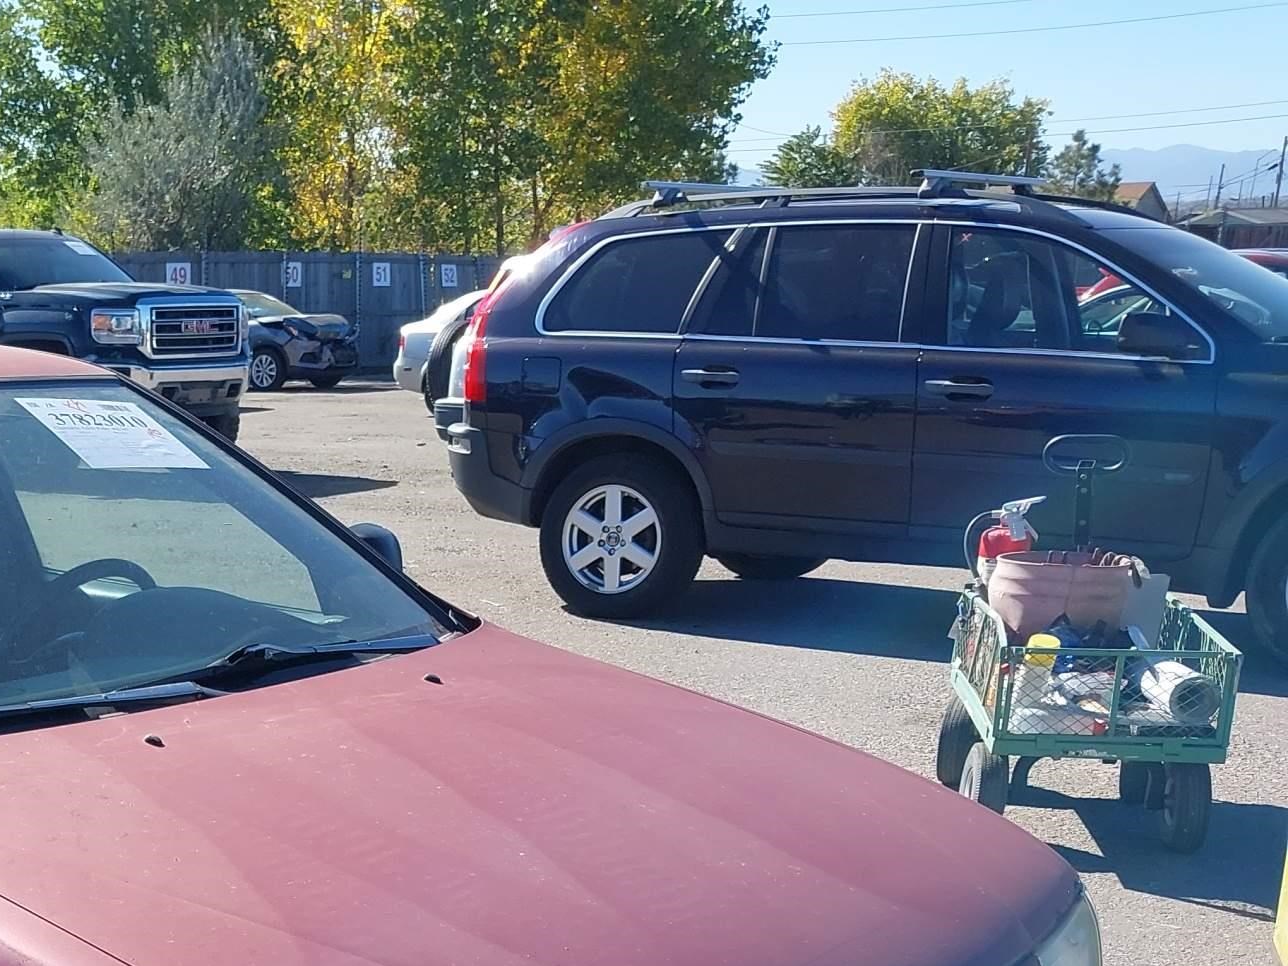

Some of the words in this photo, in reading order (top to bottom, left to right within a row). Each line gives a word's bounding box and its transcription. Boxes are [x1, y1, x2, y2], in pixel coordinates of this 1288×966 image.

[170, 266, 187, 285] 49
[375, 266, 388, 282] 51
[181, 320, 219, 333] GMC
[48, 412, 148, 429] 37823010
